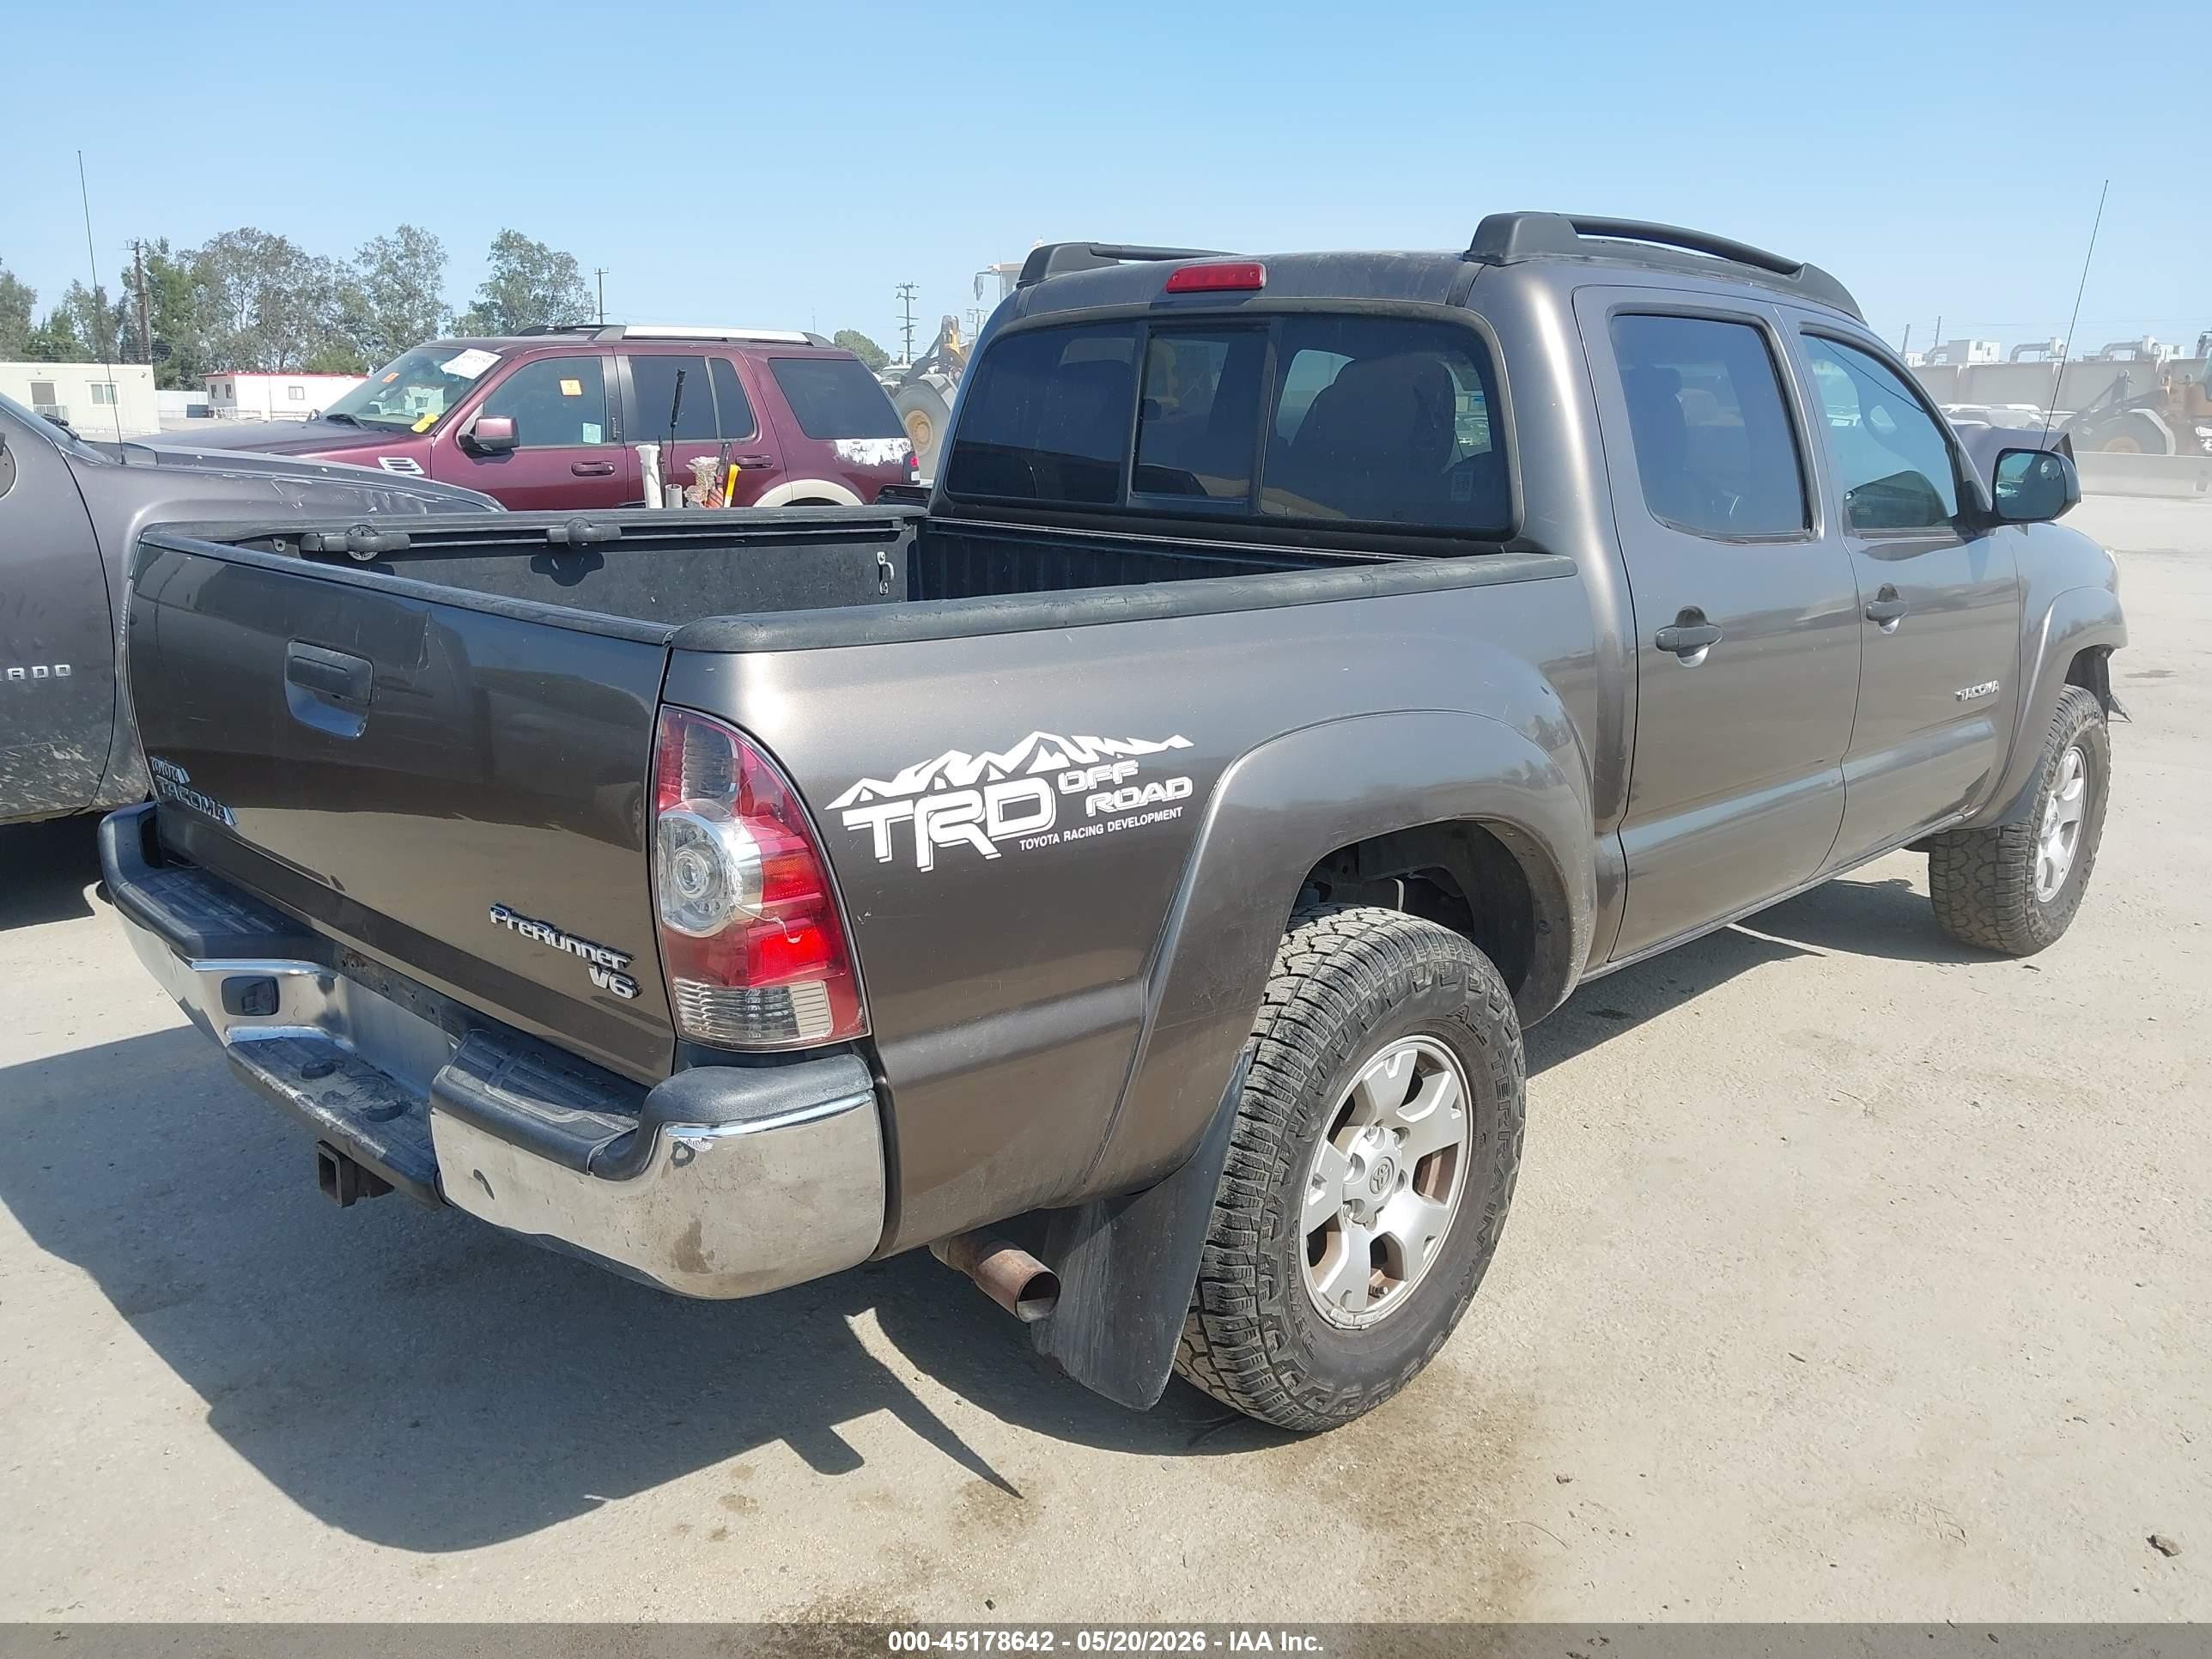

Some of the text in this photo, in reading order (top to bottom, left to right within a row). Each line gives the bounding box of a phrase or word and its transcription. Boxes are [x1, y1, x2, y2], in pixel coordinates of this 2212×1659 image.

[0, 664, 71, 682] ADO
[1954, 680, 2000, 702] TACOMA
[1057, 758, 1139, 795] OFF
[1085, 776, 1194, 817] ROAD
[155, 775, 237, 825] TACOMA
[842, 776, 1057, 872] TRD
[1019, 806, 1184, 853] TOYOTA RACING DEVELOPMENT
[489, 903, 635, 969] PreRunner
[586, 962, 642, 1000] V6
[1445, 1003, 1513, 1249] ALL TERRAIN
